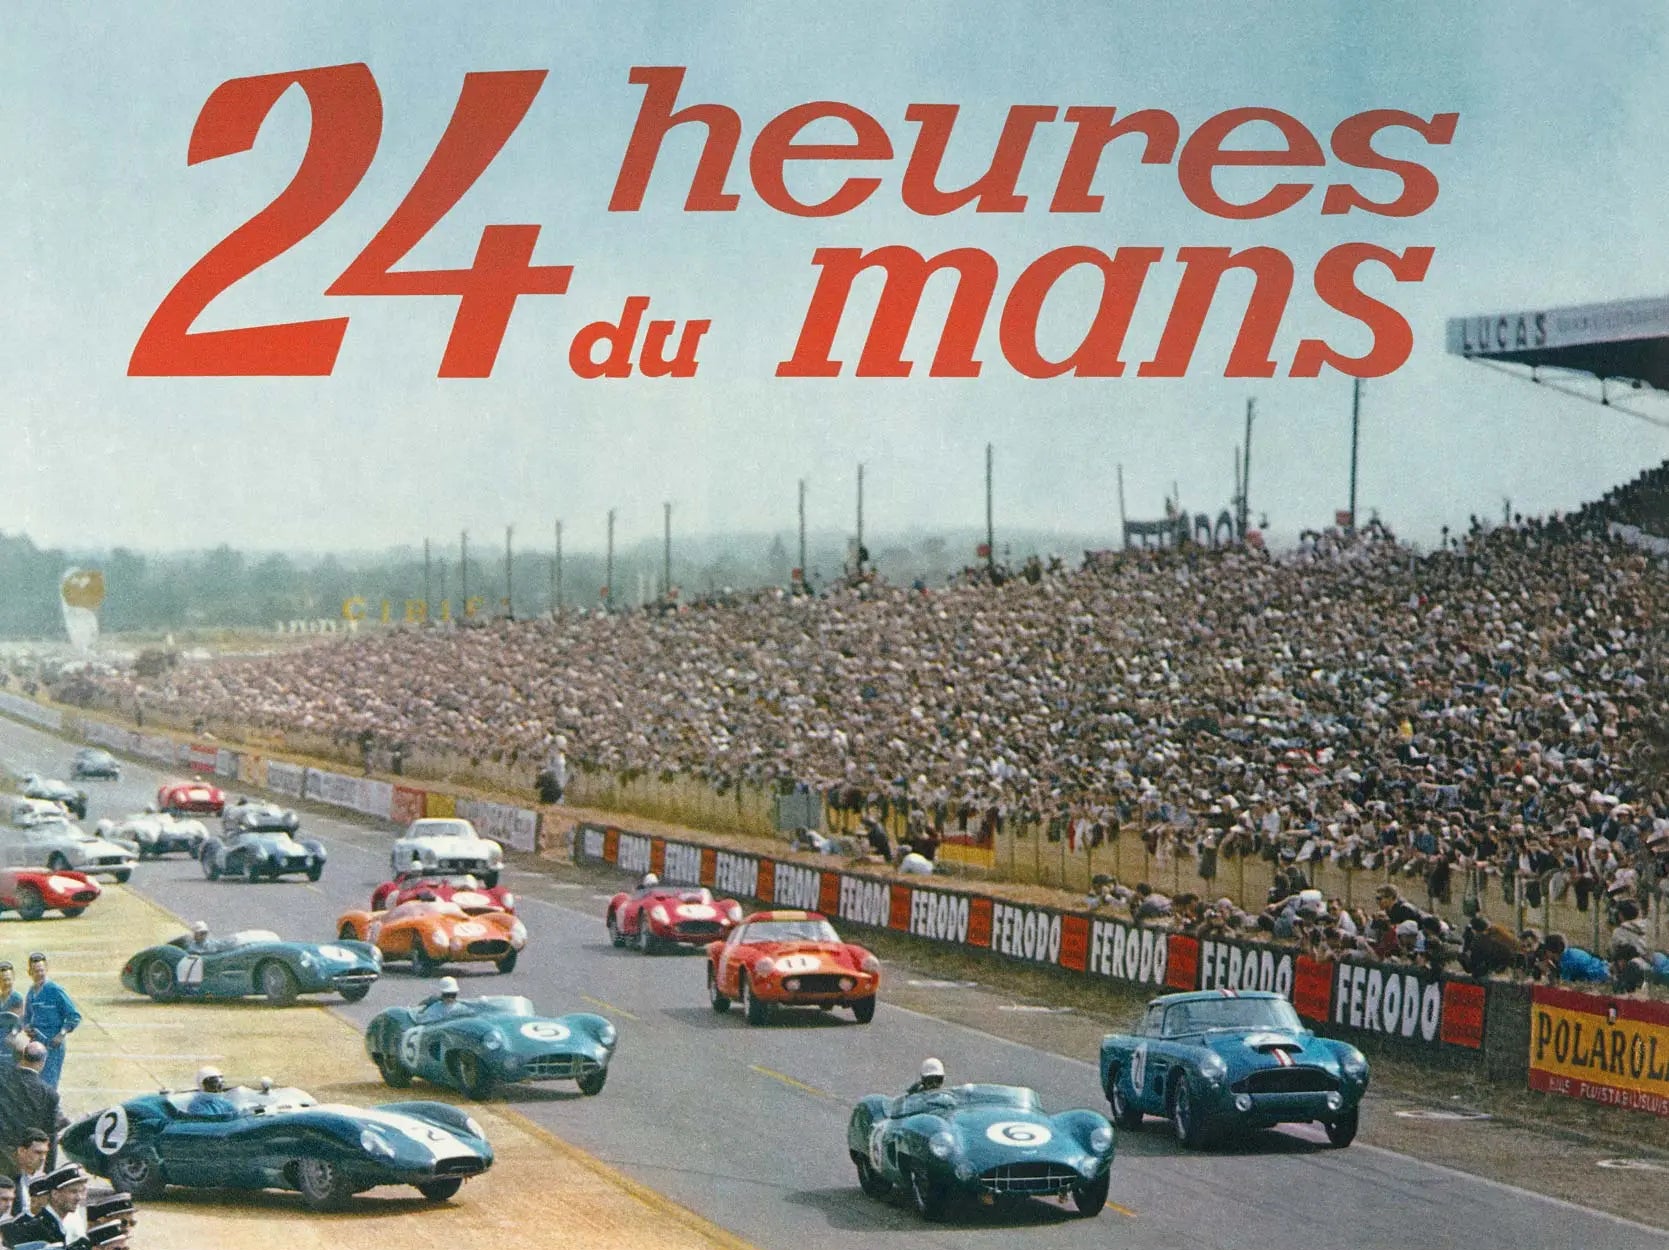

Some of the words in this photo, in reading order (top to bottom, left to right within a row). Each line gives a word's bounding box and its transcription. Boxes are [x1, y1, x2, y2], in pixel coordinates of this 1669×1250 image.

[128, 63, 572, 379] 24
[608, 66, 1459, 217] heures
[569, 296, 711, 379] du
[776, 244, 1434, 379] mans
[1463, 312, 1548, 350] LUCAS
[186, 955, 199, 983] 7
[839, 875, 891, 928] FERODO
[910, 890, 969, 944] FERODO
[991, 903, 1062, 964] FERODO
[1091, 919, 1168, 985] FERODO
[1201, 941, 1293, 998] FERODO
[1336, 963, 1441, 1041] FERODO
[532, 1025, 560, 1037] 5
[102, 1111, 119, 1149] 2
[1002, 1126, 1036, 1142] 6
